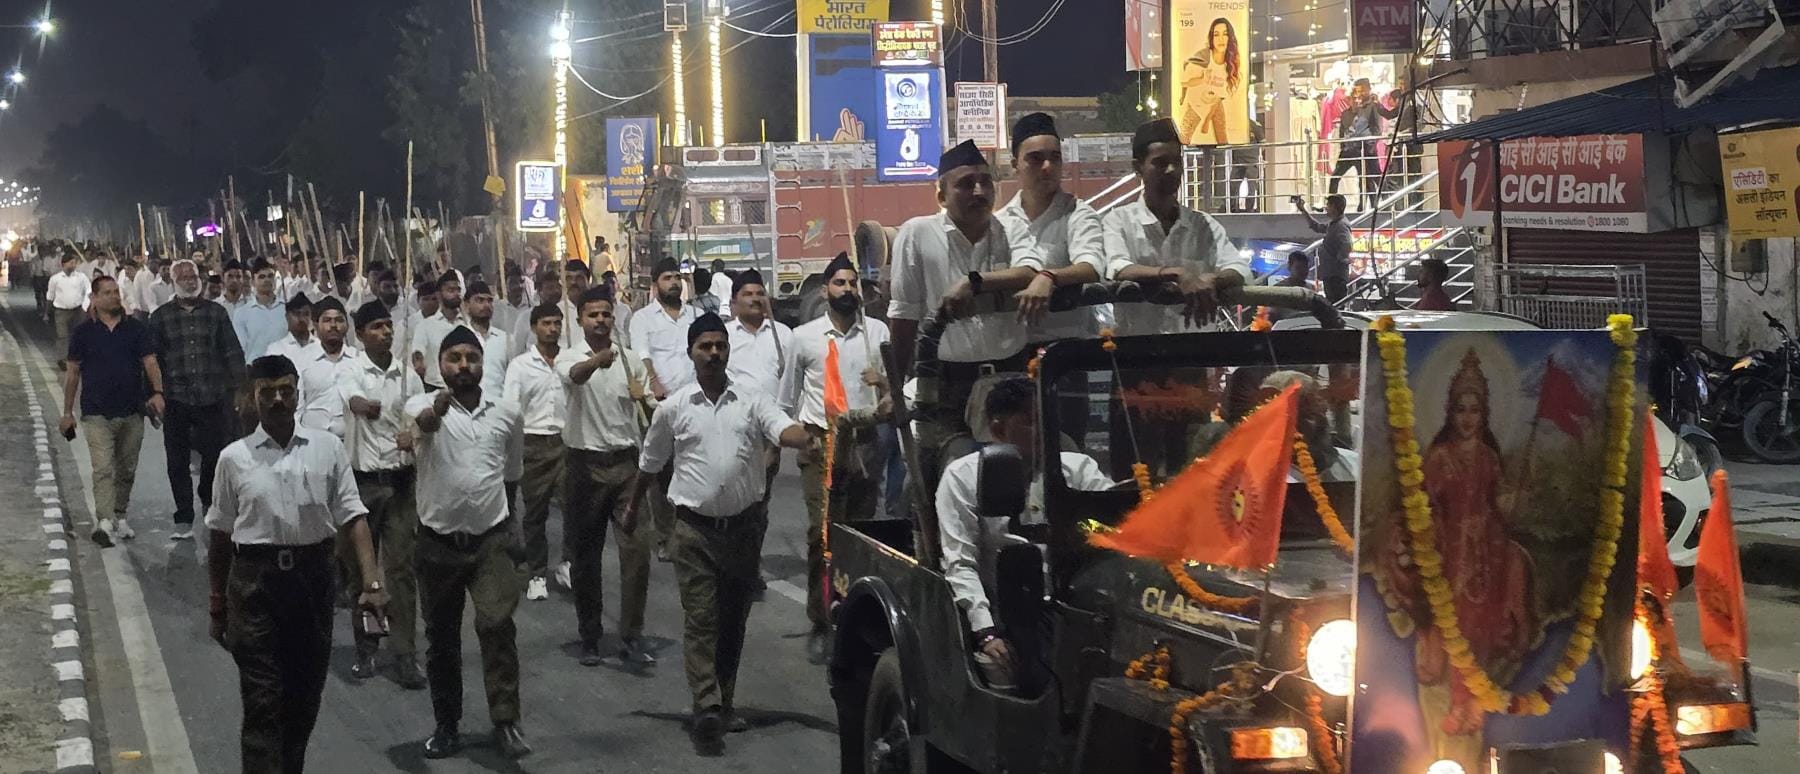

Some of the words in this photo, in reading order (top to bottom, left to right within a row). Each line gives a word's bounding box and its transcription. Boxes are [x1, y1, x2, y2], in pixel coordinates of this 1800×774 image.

[827, 1, 866, 14] भारत
[1208, 2, 1245, 10] TRENDS
[1180, 19, 1194, 27] 199
[1358, 6, 1411, 26] ATM
[1521, 137, 1537, 166] सी
[1537, 139, 1560, 170] आई
[1561, 136, 1578, 165] सी
[1579, 135, 1603, 169] आई
[1733, 170, 1765, 187] एसिडिटी
[1768, 173, 1780, 183] का
[1500, 174, 1553, 203] CICI
[1557, 173, 1626, 203] Bank
